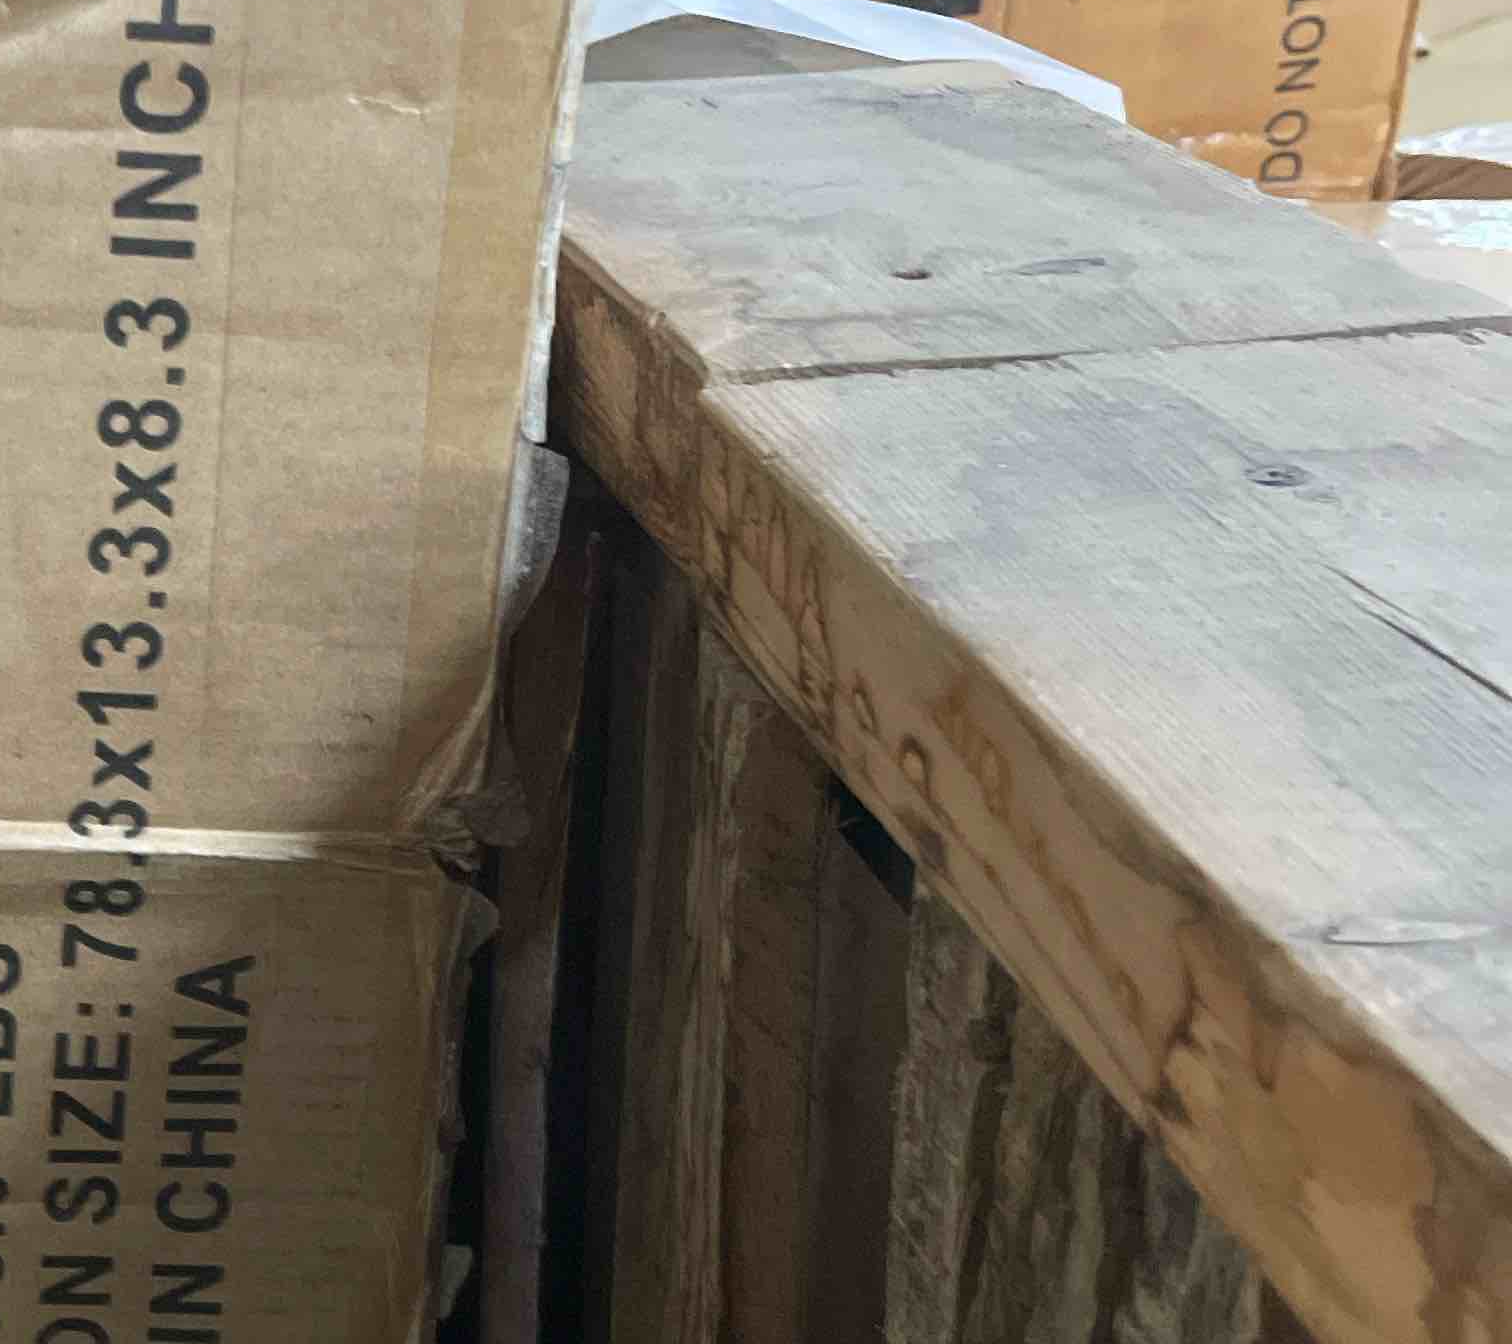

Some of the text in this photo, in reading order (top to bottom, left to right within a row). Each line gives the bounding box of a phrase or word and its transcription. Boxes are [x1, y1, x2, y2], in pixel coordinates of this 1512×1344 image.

[1259, 108, 1310, 184] DO
[45, 1003, 133, 1224] SIZE:
[156, 955, 255, 1234] CHINA
[147, 1263, 225, 1344] IN
